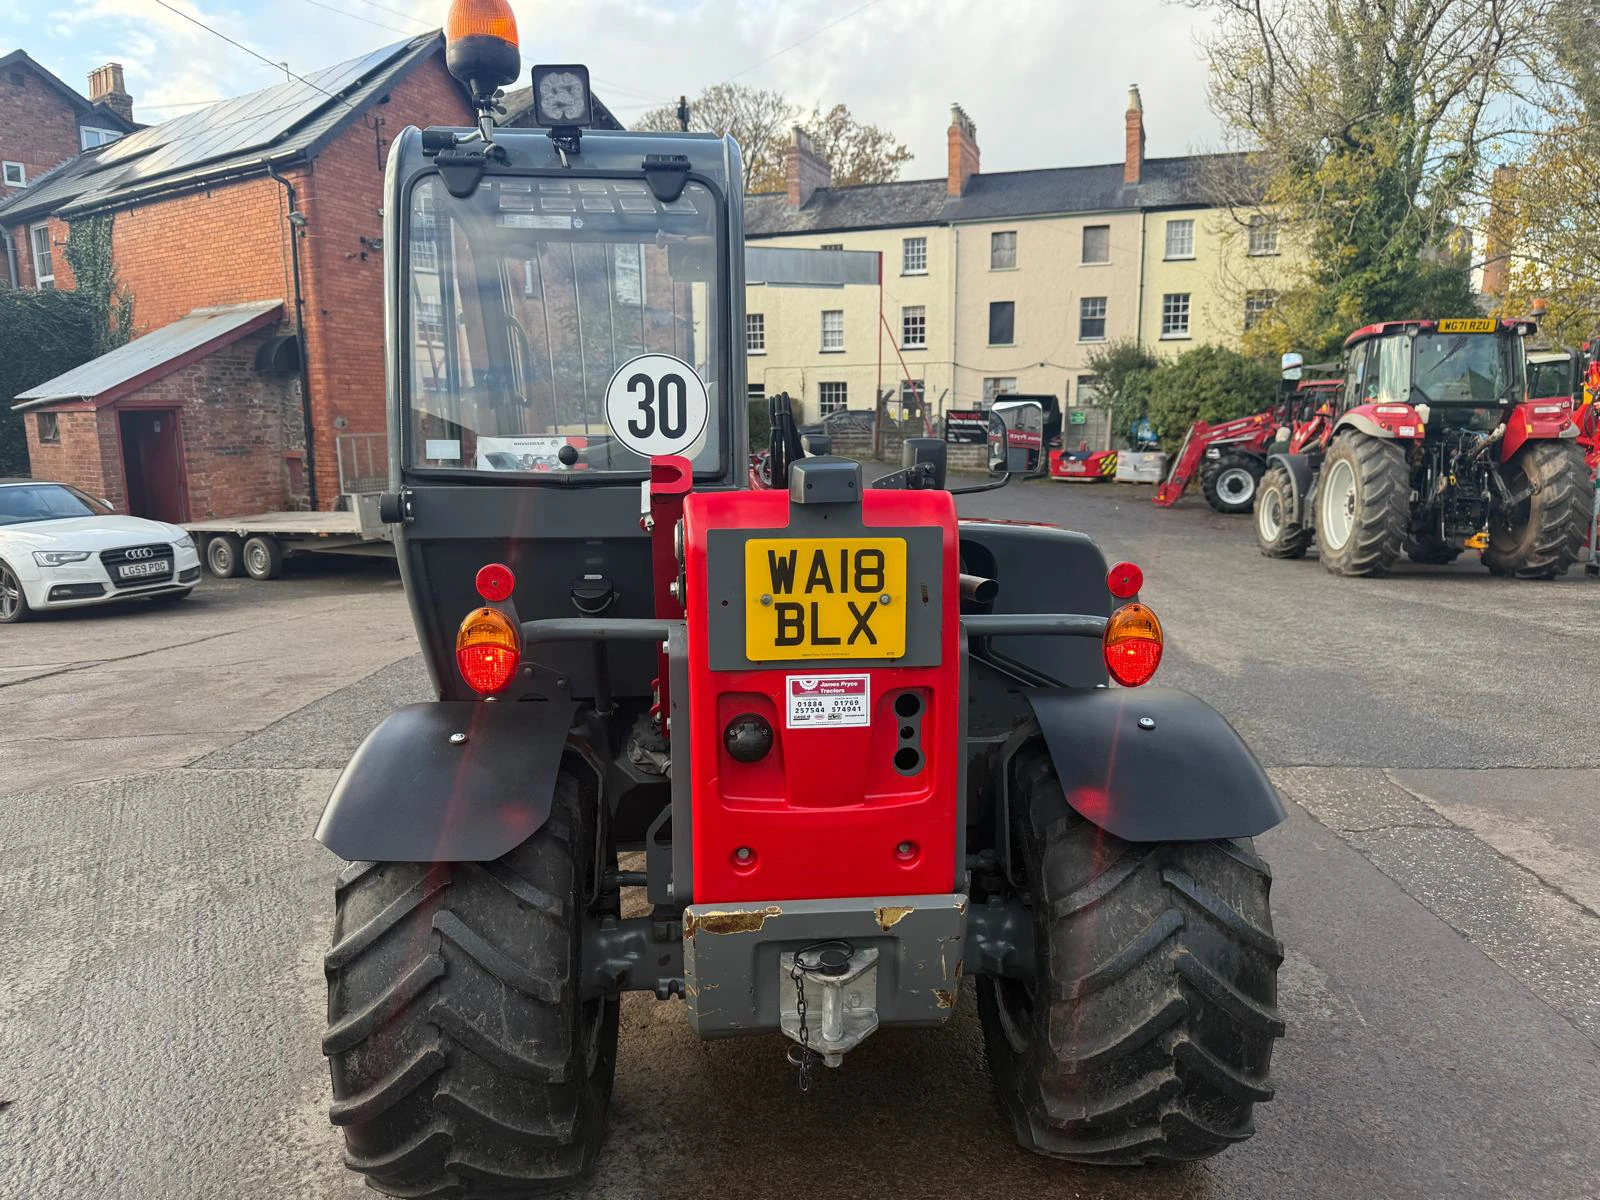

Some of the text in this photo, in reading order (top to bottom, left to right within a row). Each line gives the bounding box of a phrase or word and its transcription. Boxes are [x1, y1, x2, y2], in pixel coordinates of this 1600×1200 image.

[1444, 321, 1490, 330] WG71 RZU
[627, 373, 687, 439] 30
[122, 561, 166, 576] LG59 PDG
[768, 549, 885, 595] WA18
[775, 601, 878, 646] BLX
